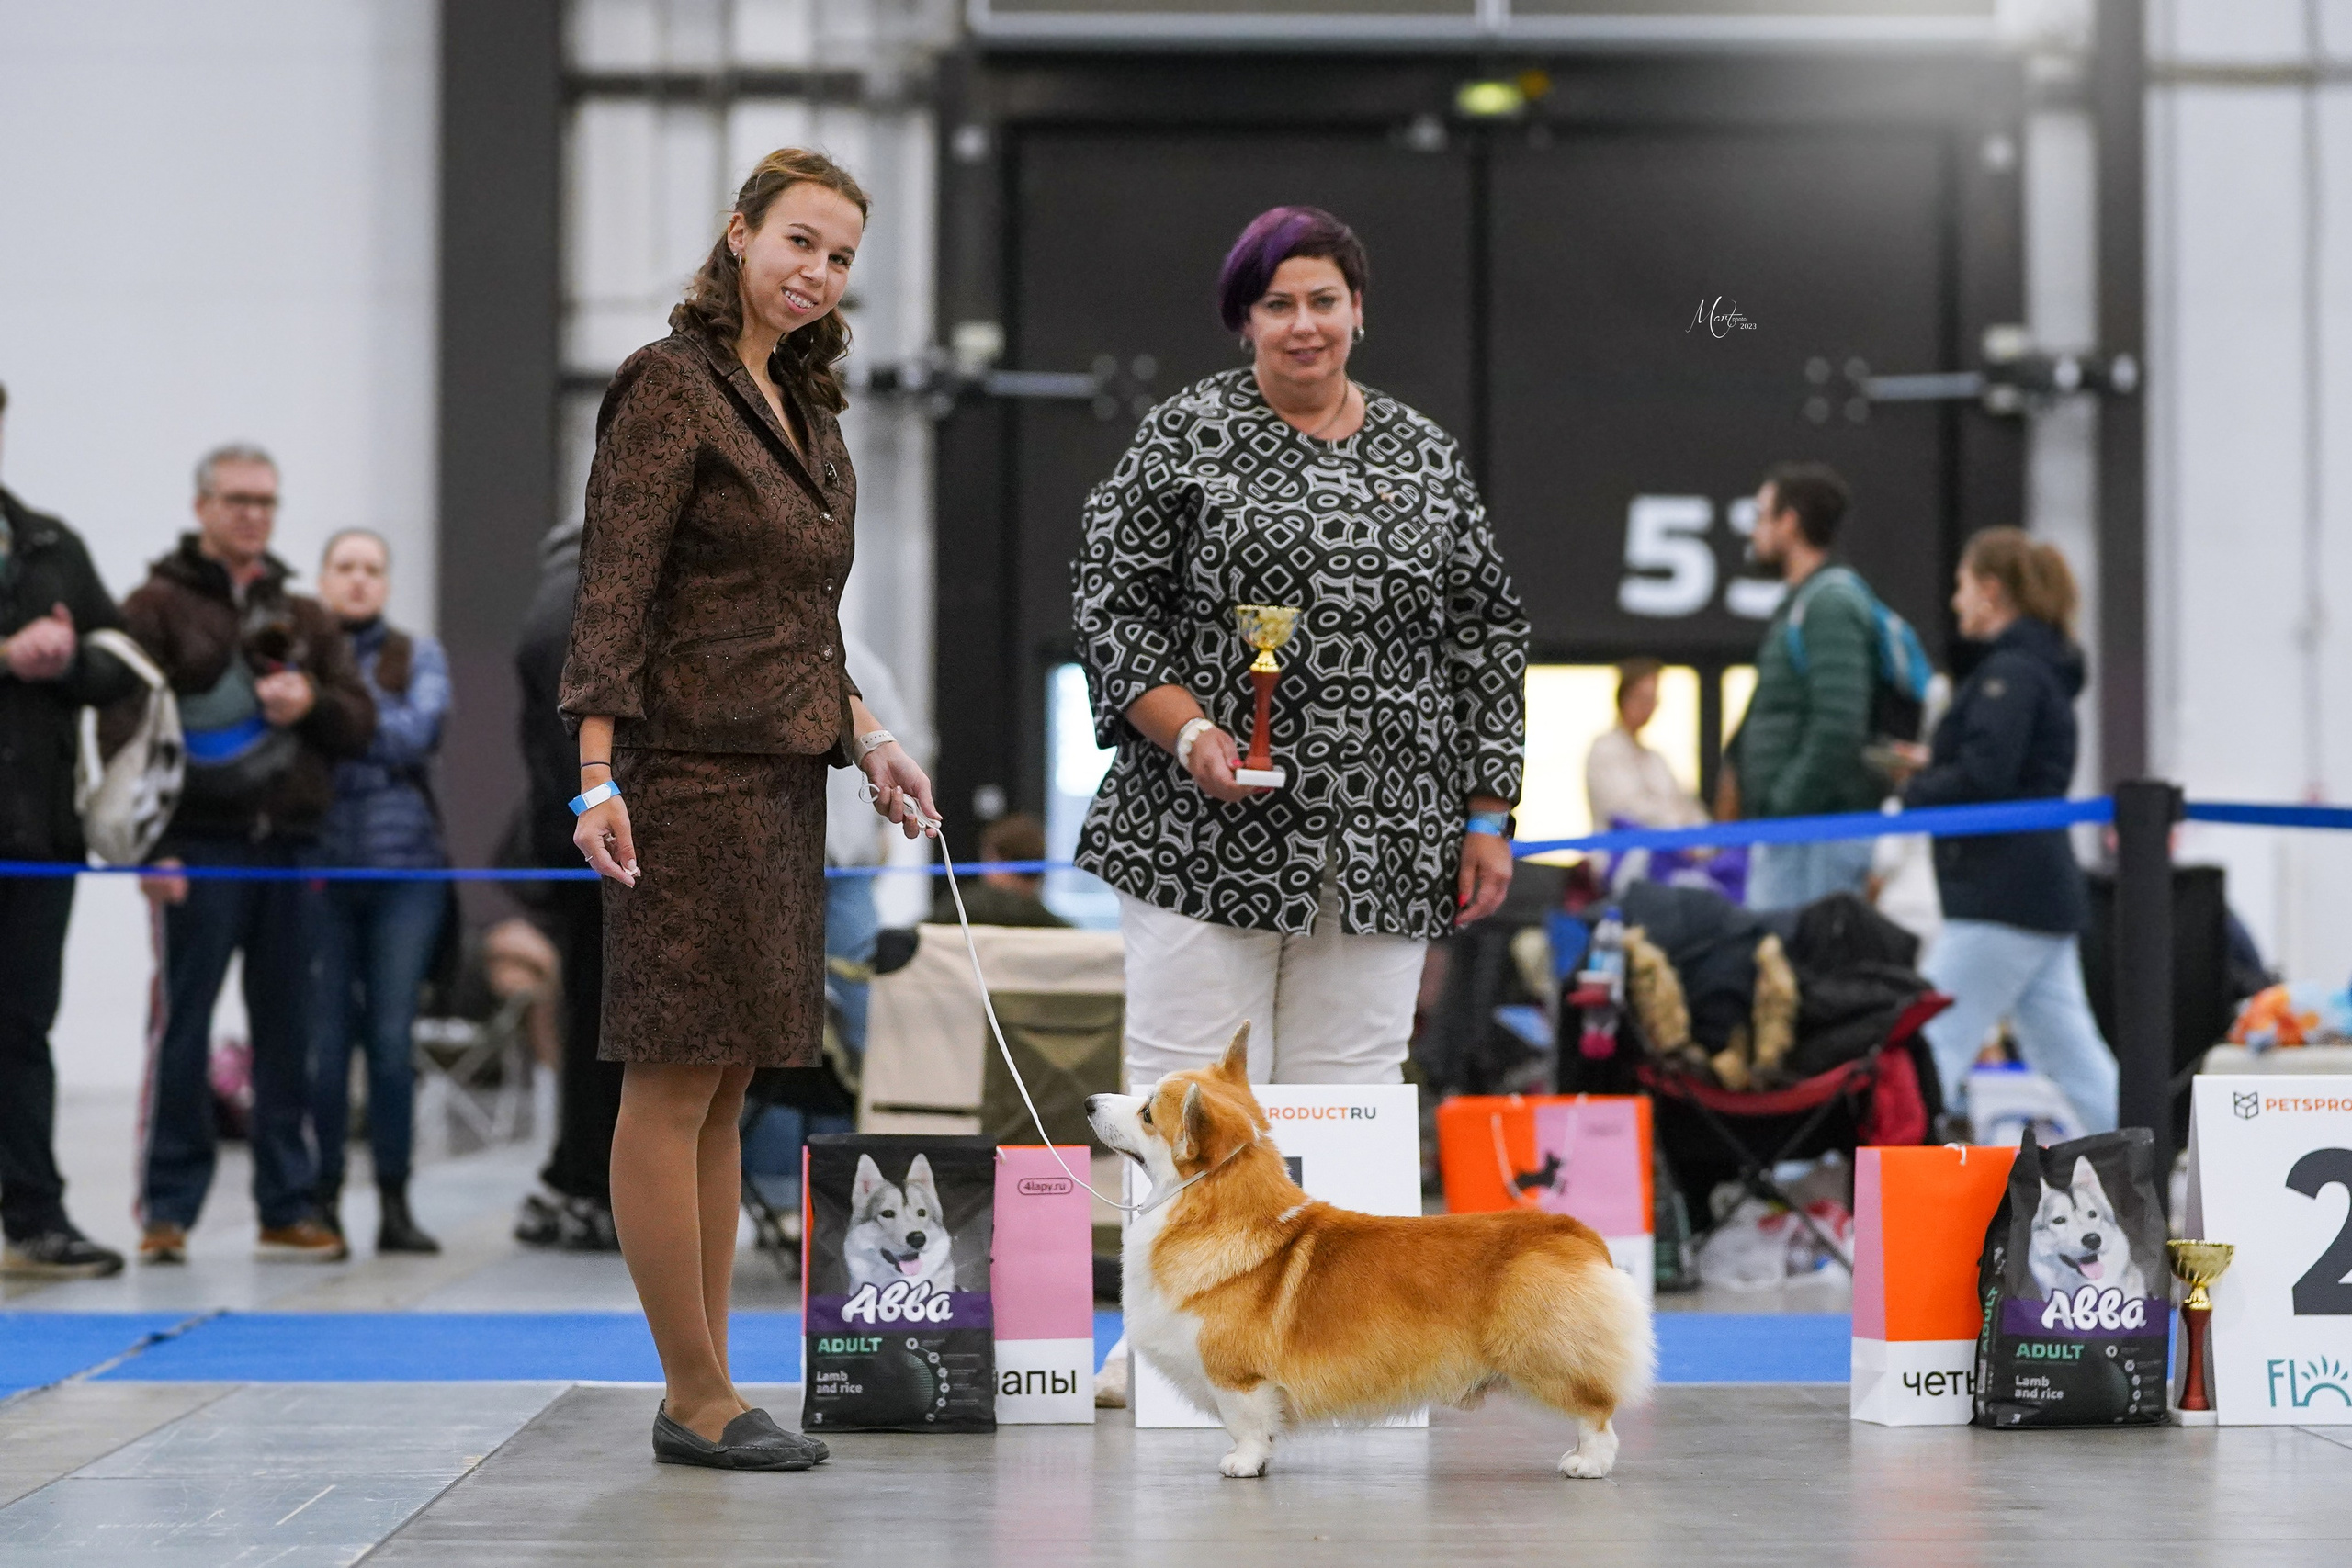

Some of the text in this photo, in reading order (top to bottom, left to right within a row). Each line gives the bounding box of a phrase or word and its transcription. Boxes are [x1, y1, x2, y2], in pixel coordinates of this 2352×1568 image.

[1262, 1106, 1377, 1120] RODUCTRU
[1023, 1181, 1066, 1192] 4lapy.ru
[2285, 1147, 2352, 1315] 2
[818, 1337, 883, 1353] ADULT
[2015, 1342, 2085, 1359] ADULT
[816, 1371, 848, 1382] Lamb
[995, 1369, 1076, 1395] апы
[2015, 1375, 2050, 1387] Lamb
[816, 1382, 864, 1393] and rice
[2014, 1387, 2064, 1400] and rice
